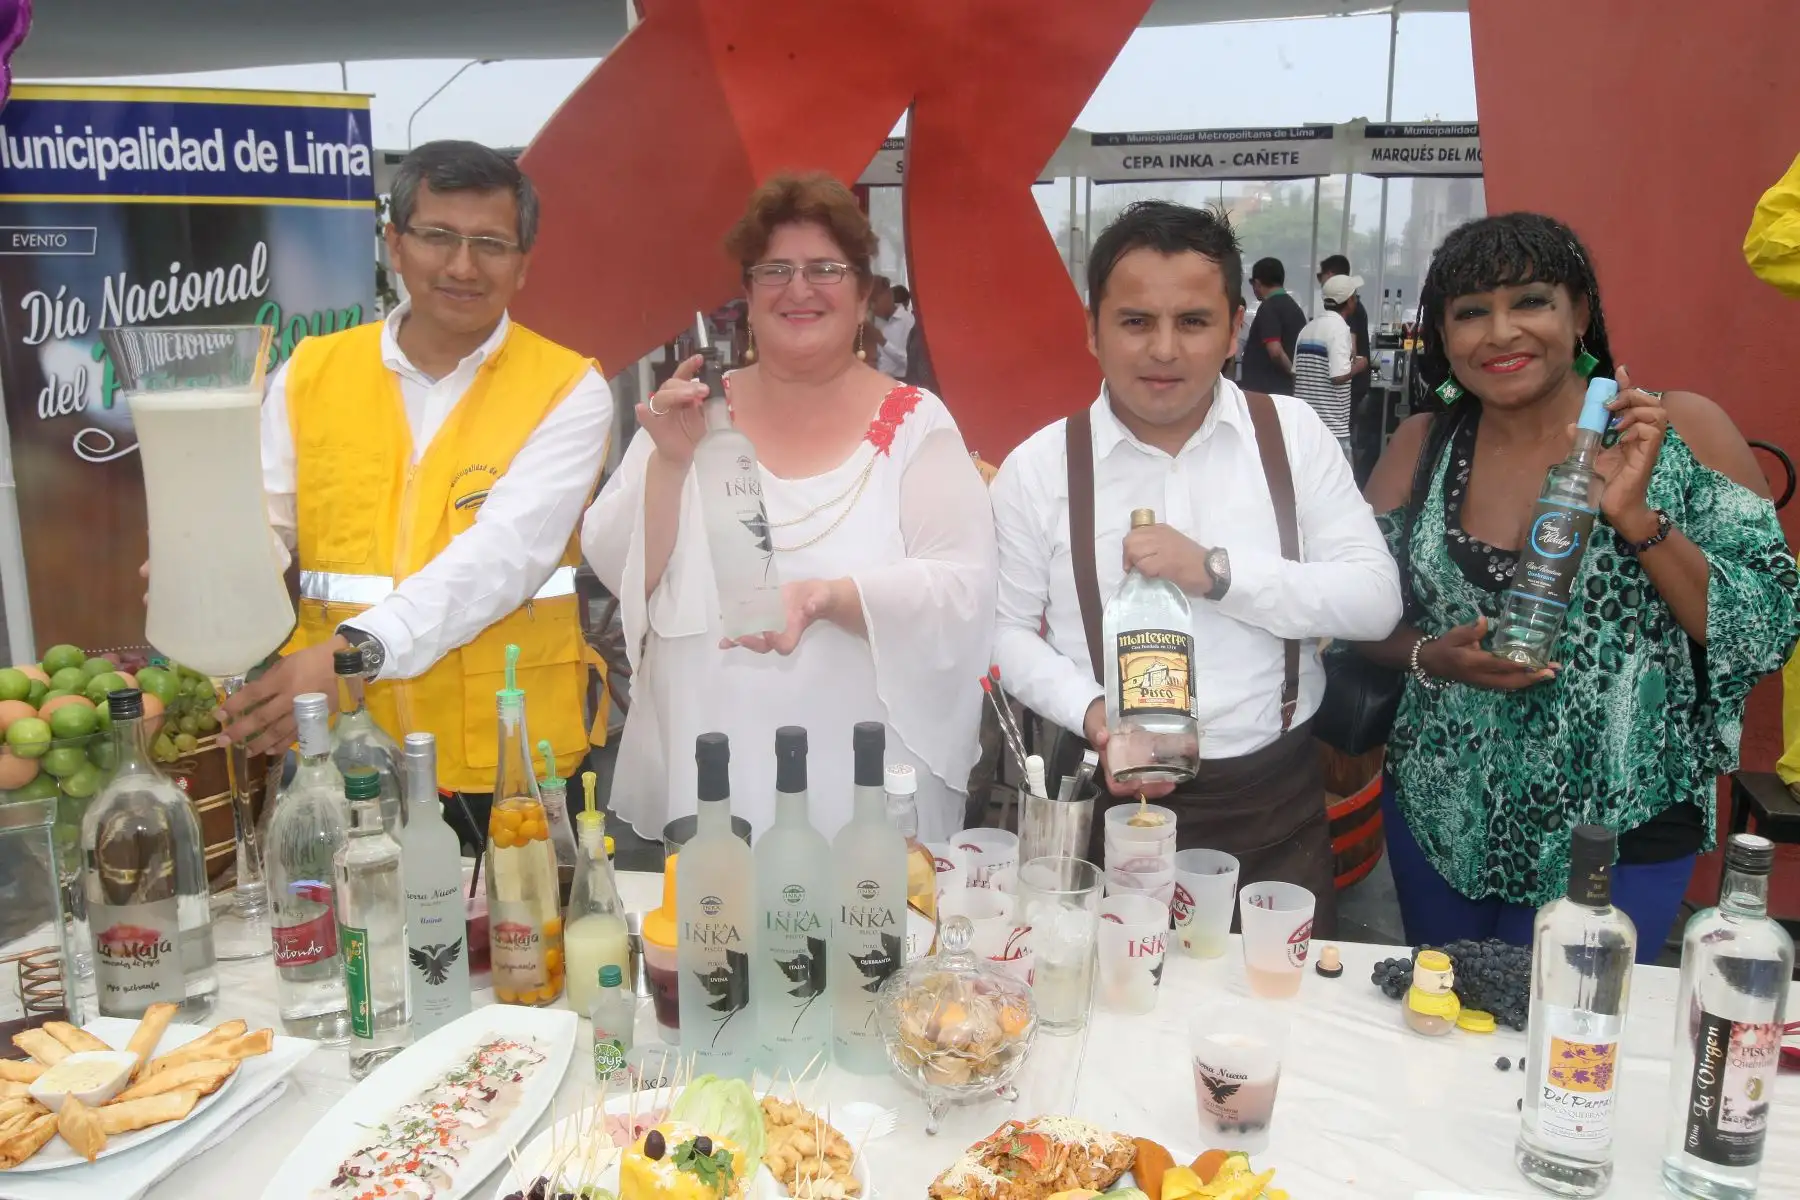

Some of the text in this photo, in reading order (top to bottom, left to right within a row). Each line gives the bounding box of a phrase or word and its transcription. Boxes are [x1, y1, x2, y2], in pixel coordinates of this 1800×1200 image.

[1127, 128, 1315, 144] Municipalidad Metropolitana de Lima
[1404, 125, 1477, 137] Municipalidad
[234, 129, 278, 173] de
[287, 130, 371, 177] Lima
[1122, 155, 1164, 170] CEPA
[1169, 154, 1214, 169] INKA
[1232, 148, 1300, 167] CAÑETE
[1371, 144, 1434, 162] MARQUÉS
[1438, 148, 1460, 162] DEL
[12, 233, 68, 249] EVENTO
[20, 240, 271, 346] Día Nacional
[37, 365, 88, 420] del
[1118, 631, 1187, 648] Montesierpe
[840, 904, 896, 929] INKA
[1174, 900, 1190, 914] KA
[766, 910, 823, 933] INKA
[684, 921, 742, 946] INKA
[97, 938, 172, 961] La Maja
[273, 940, 324, 961] Rotondo
[1696, 1025, 1723, 1089] Virgen
[1217, 1067, 1249, 1080] Nueva
[1544, 1086, 1569, 1105] Del
[1693, 1094, 1716, 1121] La
